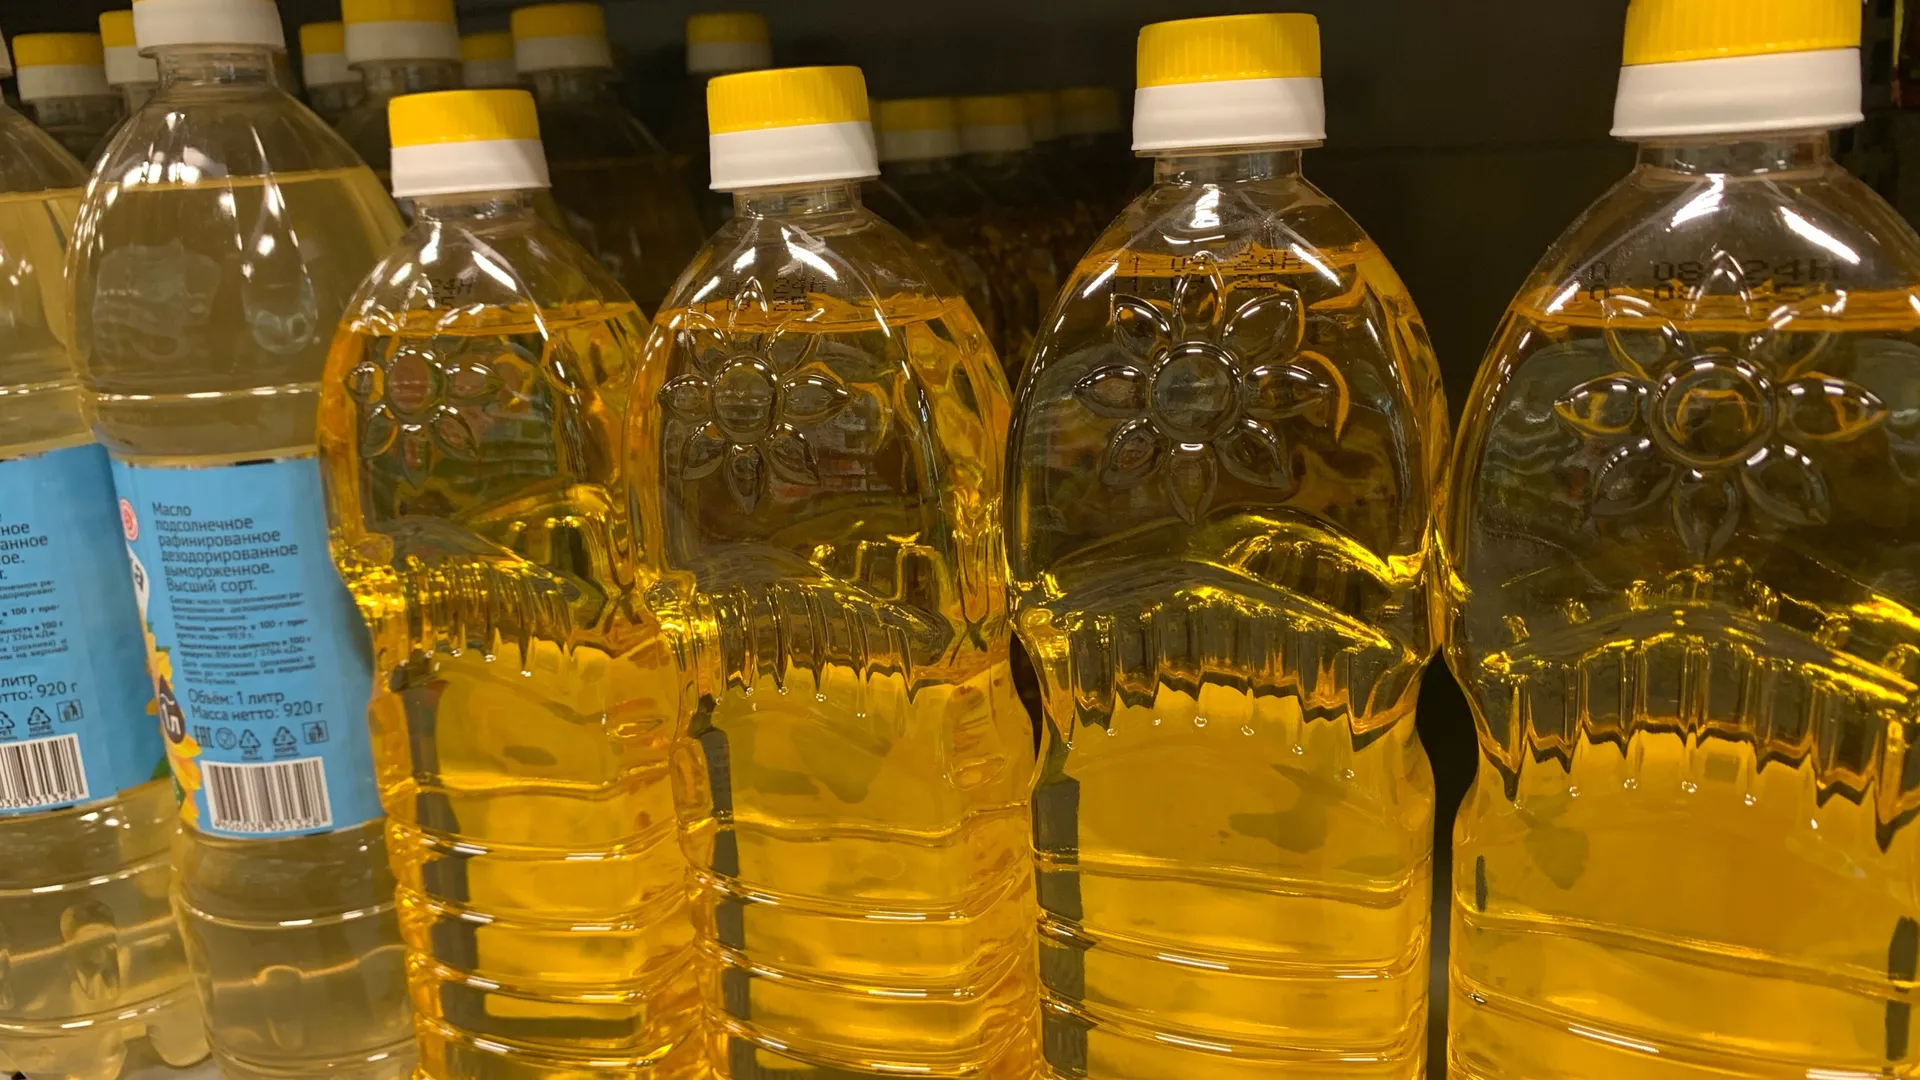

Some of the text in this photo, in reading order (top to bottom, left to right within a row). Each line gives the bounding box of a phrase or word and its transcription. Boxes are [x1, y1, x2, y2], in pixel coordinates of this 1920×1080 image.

[152, 502, 192, 517] Масло
[155, 517, 253, 533] подсолнечное
[158, 530, 281, 550] рафинированное
[161, 543, 299, 565] дезодорированное
[164, 562, 275, 579] вымороженное.
[166, 576, 258, 595] Высший сорт.
[36, 682, 67, 698] 920
[248, 692, 285, 706] литр
[191, 704, 229, 721] Масса
[231, 708, 280, 721] нетто:
[283, 700, 313, 717] 920
